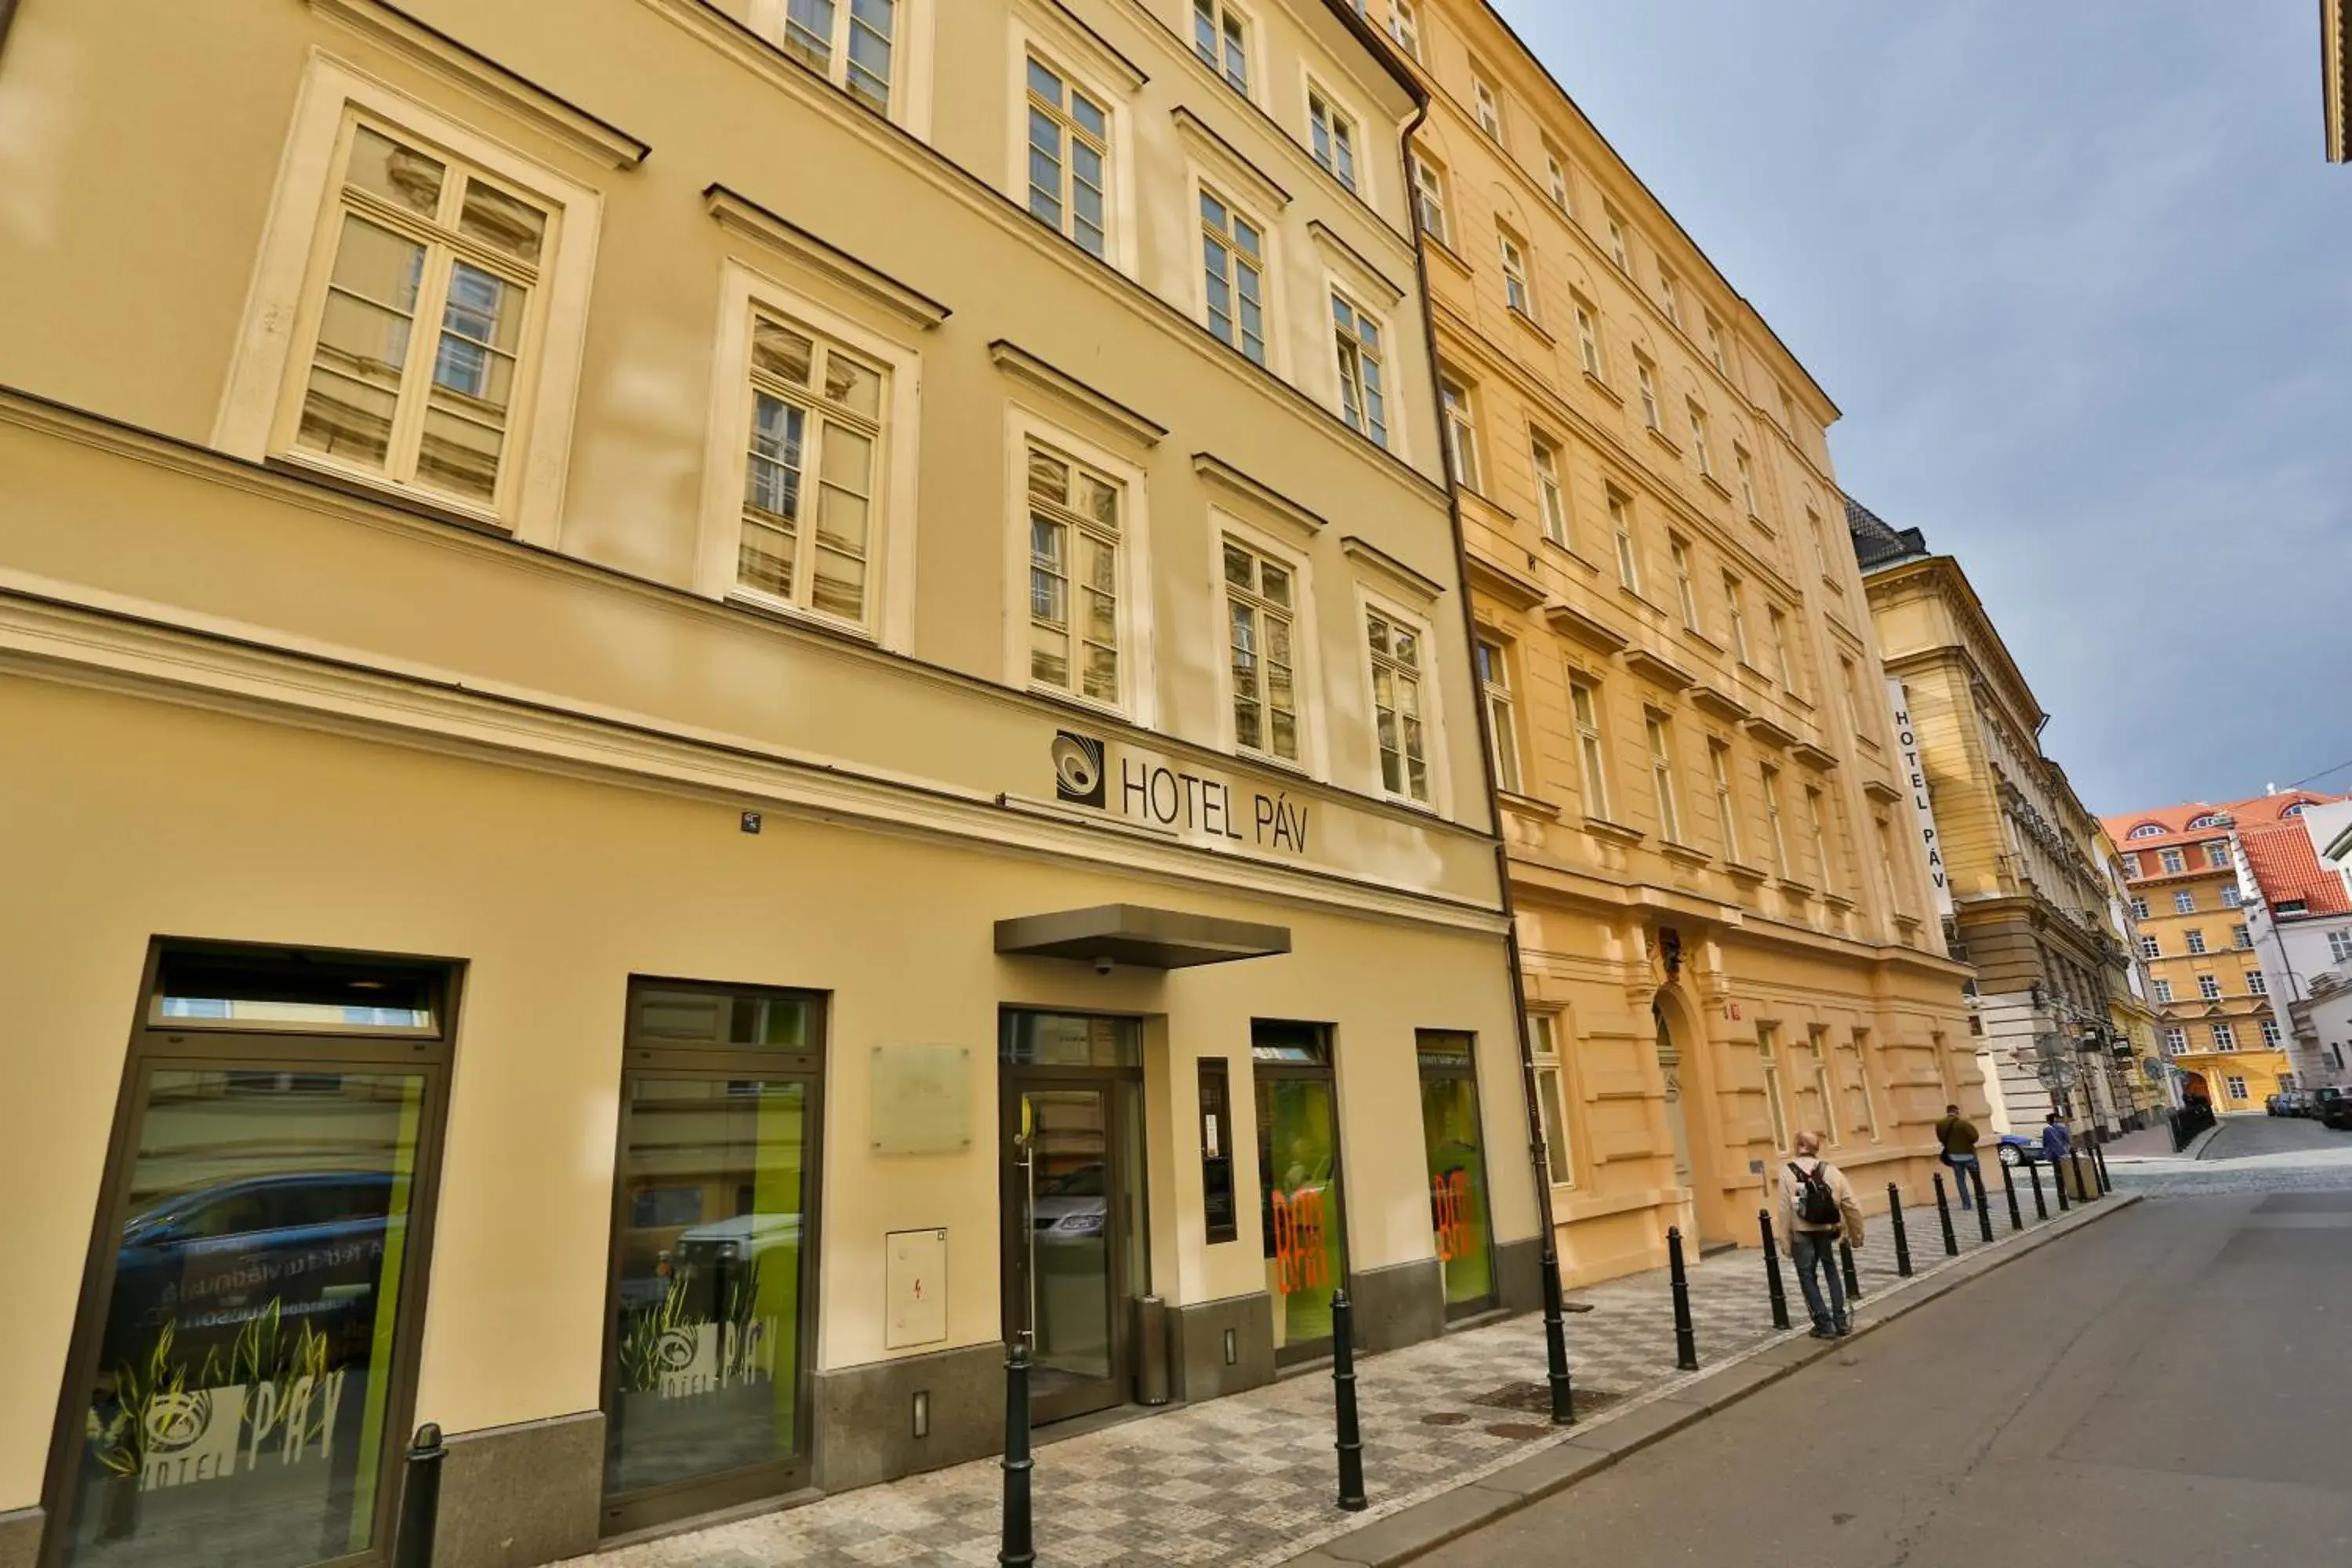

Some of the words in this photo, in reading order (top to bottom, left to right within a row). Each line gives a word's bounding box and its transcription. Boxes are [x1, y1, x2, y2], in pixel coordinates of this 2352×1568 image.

[1122, 757, 1243, 840] HOTEL
[1254, 792, 1308, 854] PÁV
[1895, 711, 1928, 810] HOTEL
[1923, 828, 1945, 888] PÁV
